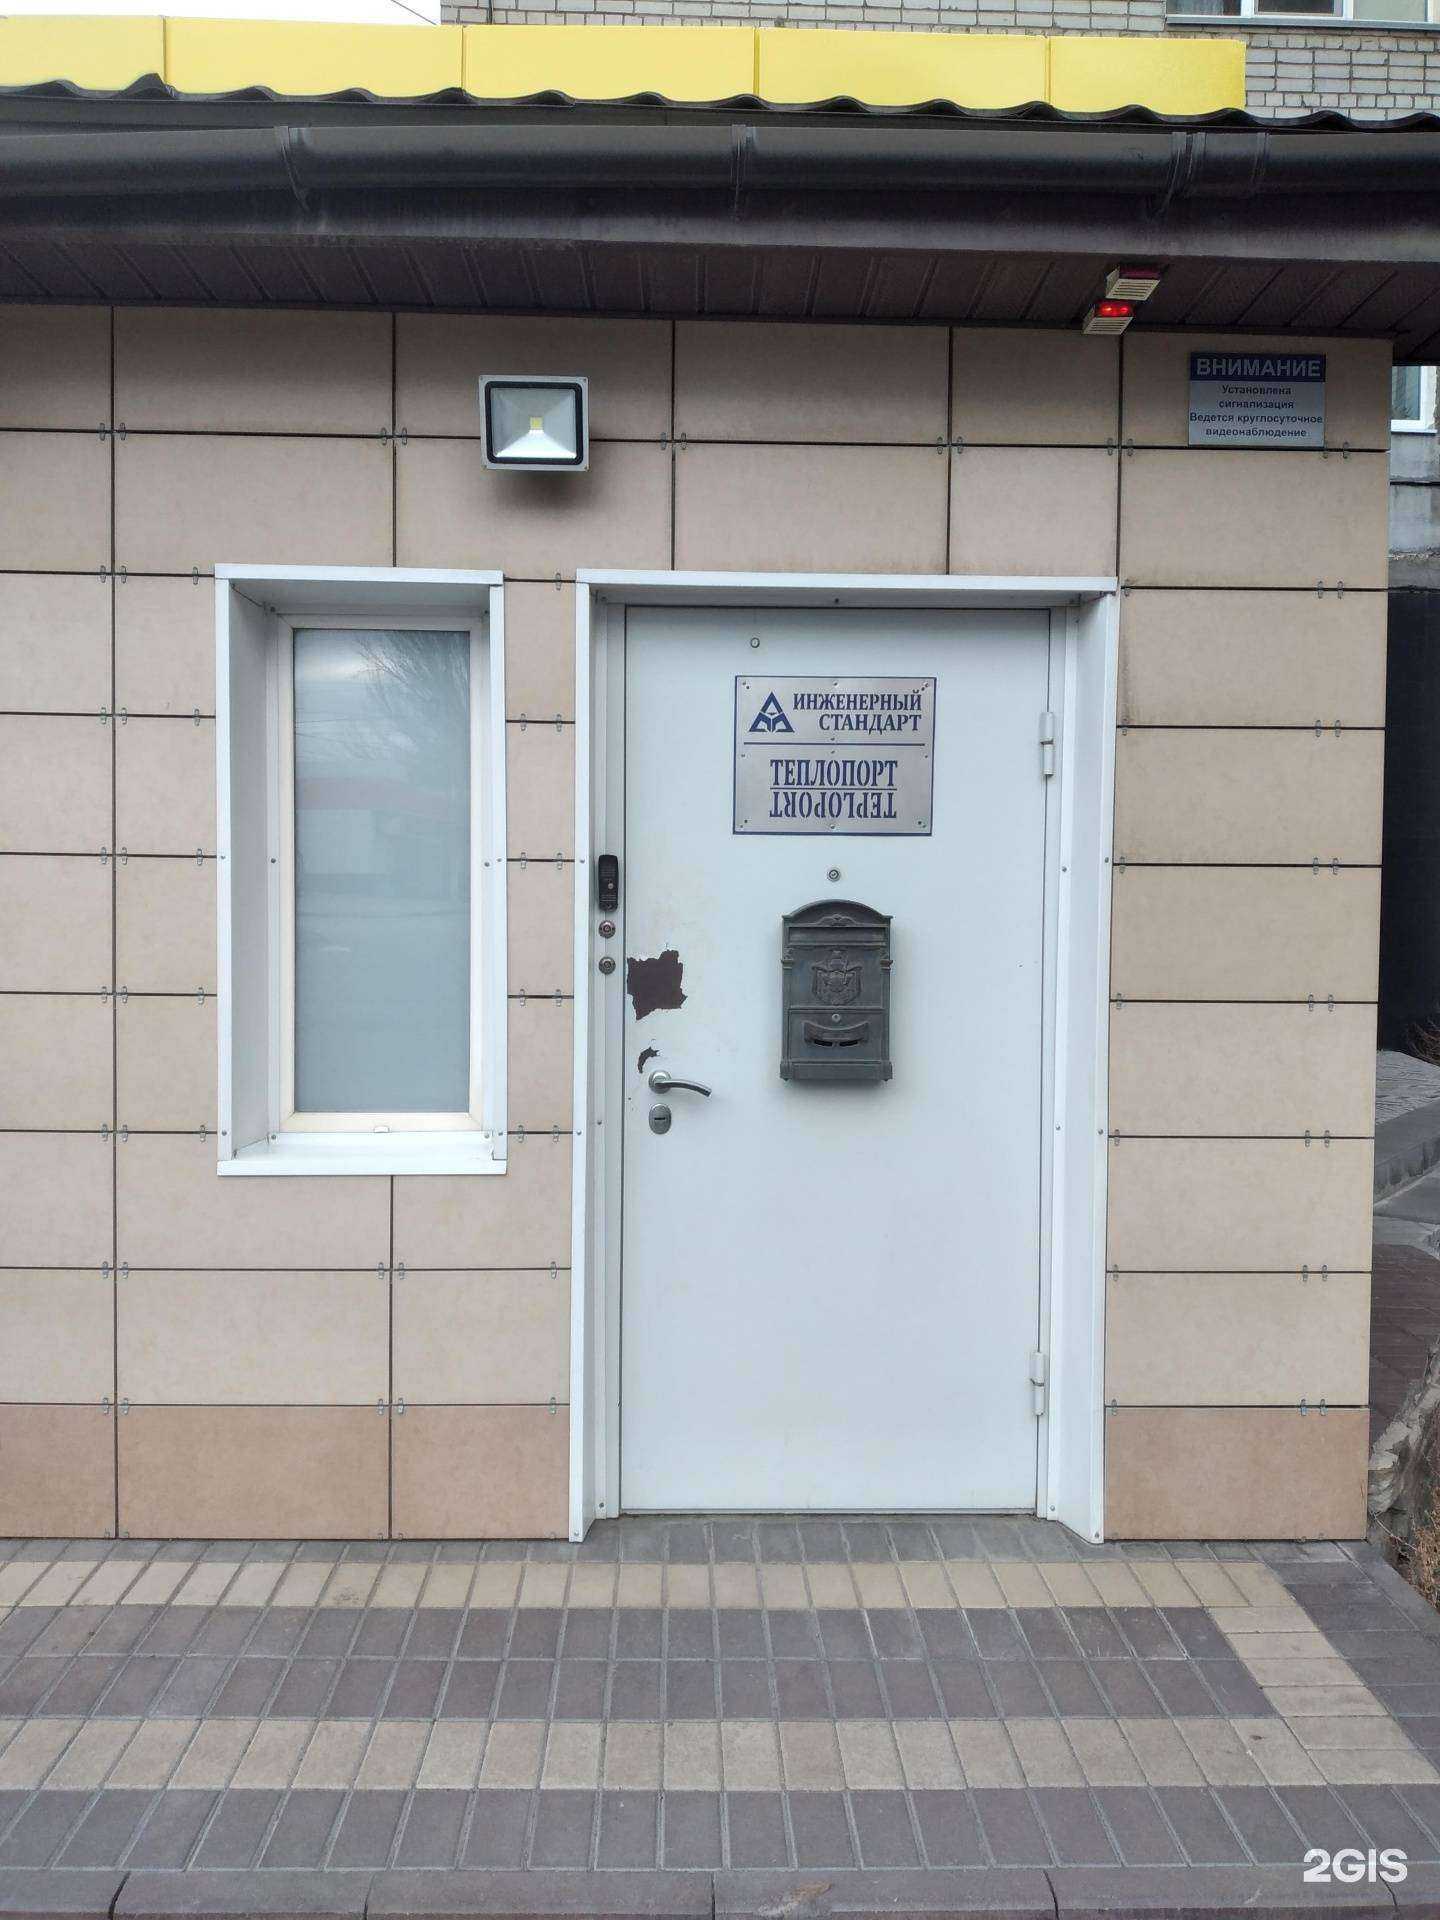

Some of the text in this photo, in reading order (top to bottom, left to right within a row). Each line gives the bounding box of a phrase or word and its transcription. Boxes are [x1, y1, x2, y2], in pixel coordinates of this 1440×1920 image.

[1196, 358, 1321, 377] ВНИМАНИЕ
[1221, 384, 1292, 396] Установлена
[1218, 399, 1295, 410] сигнализация
[1190, 412, 1323, 425] Ведется круглосуточное
[1205, 427, 1308, 438] видеонаблюдение
[793, 689, 922, 711] ИНЖЕНЕРНЫЙ
[818, 713, 922, 735] СТАНДАРТ
[769, 759, 898, 787] ТЕПЛОПОРТ
